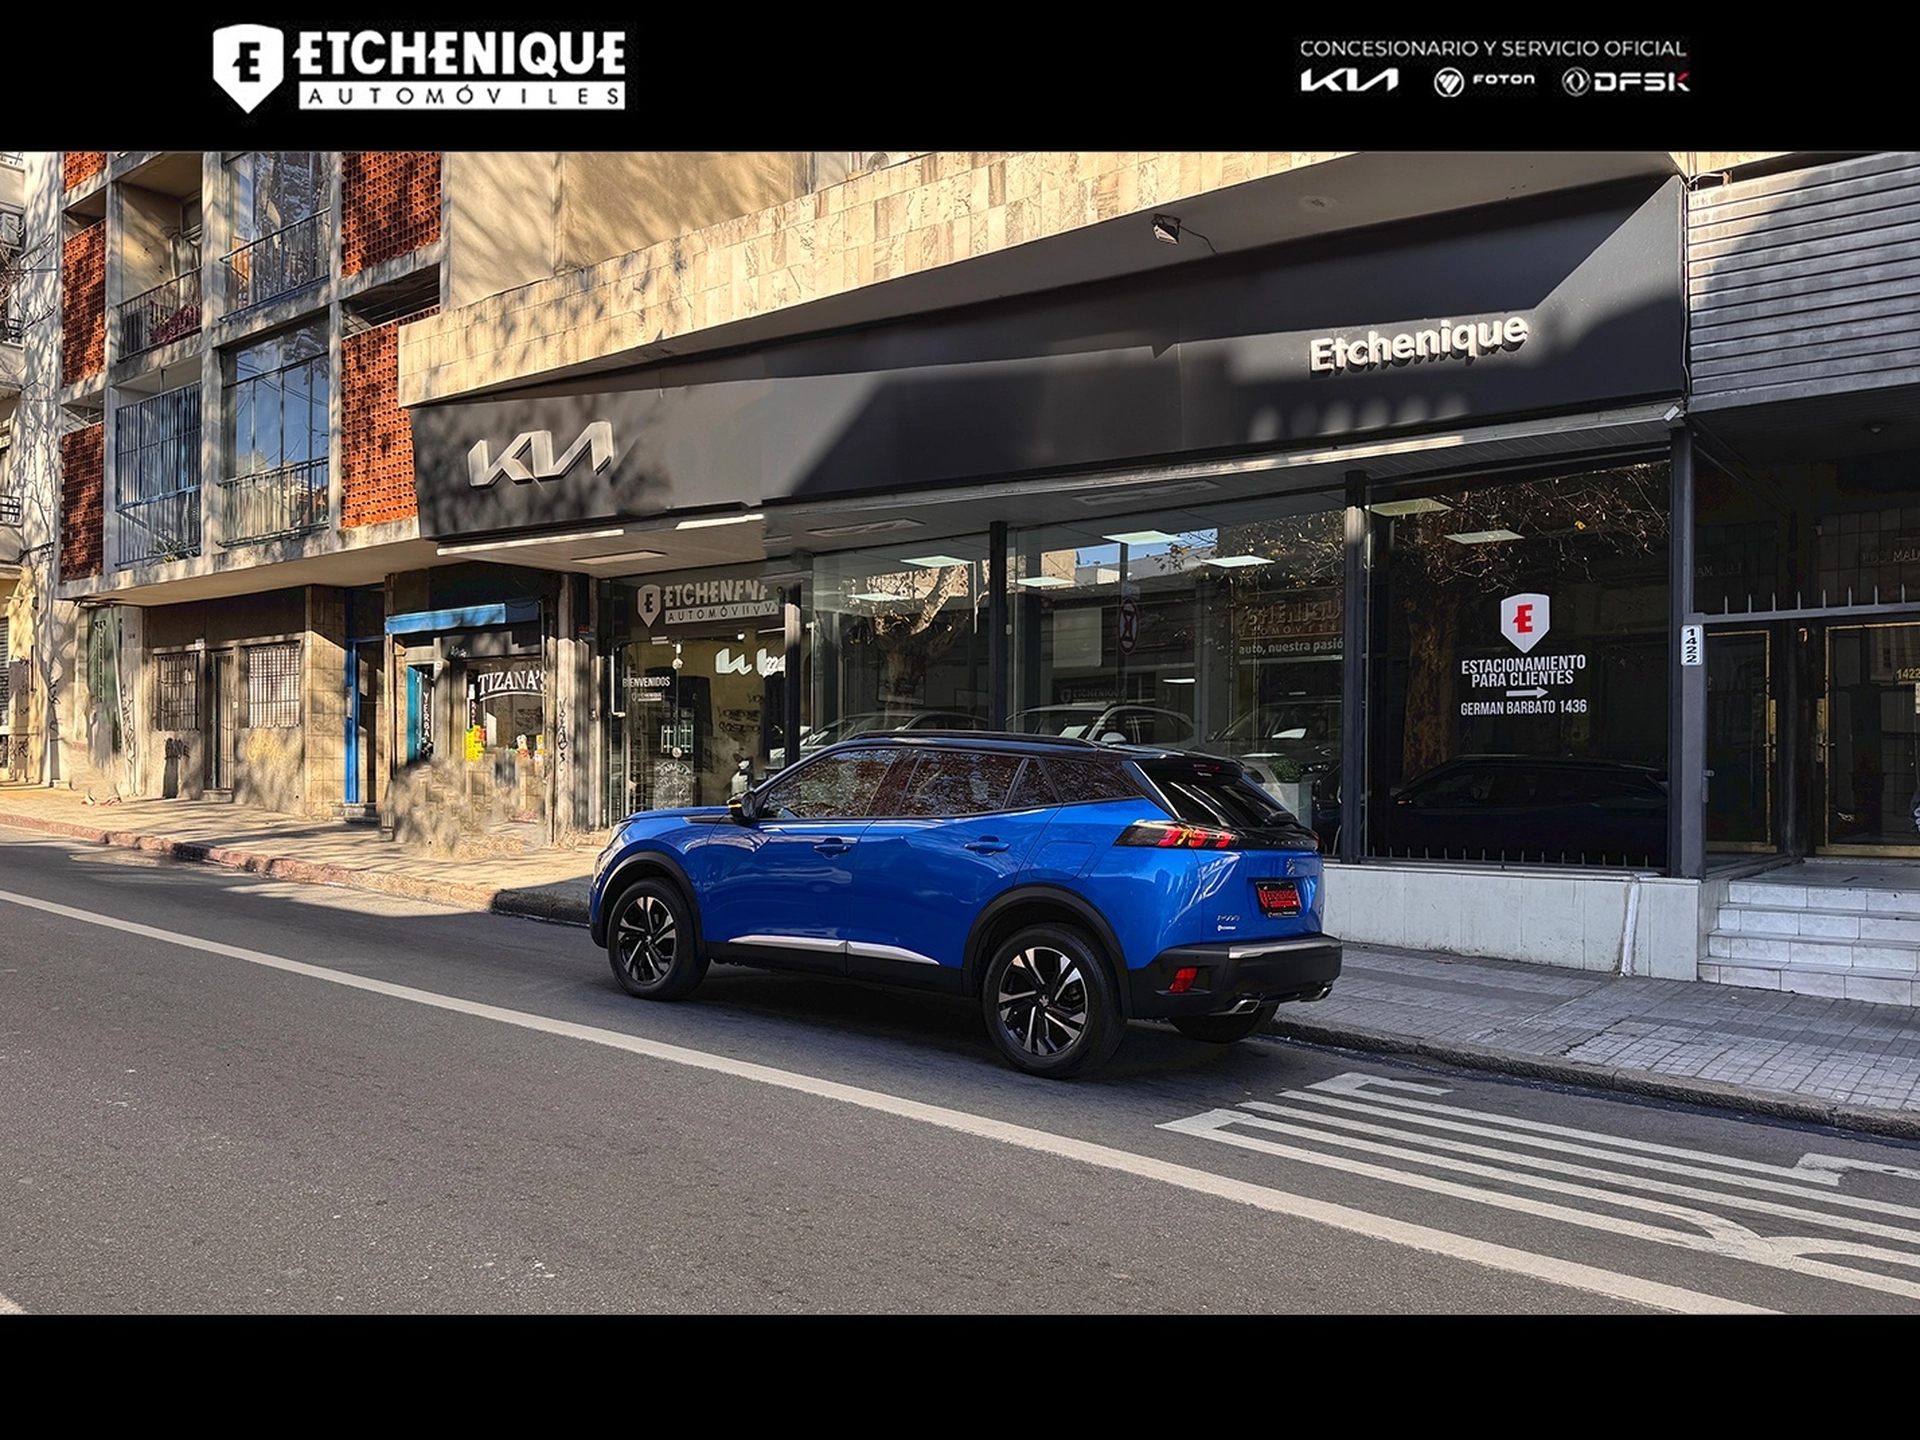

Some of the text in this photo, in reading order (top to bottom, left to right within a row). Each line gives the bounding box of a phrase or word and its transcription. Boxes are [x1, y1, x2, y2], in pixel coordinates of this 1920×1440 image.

[1310, 316, 1529, 371] Etchenique
[468, 421, 614, 487] KIA
[1238, 644, 1266, 656] auto,
[1268, 641, 1311, 653] nuestra
[1685, 628, 1697, 663] 1422
[1461, 654, 1586, 675] ESTACIONAMIENTO
[622, 676, 671, 687] BIENVENIDOS
[1471, 670, 1574, 688] PARA CLIENTES
[1460, 698, 1587, 716] GERMAN BARBATO 1436
